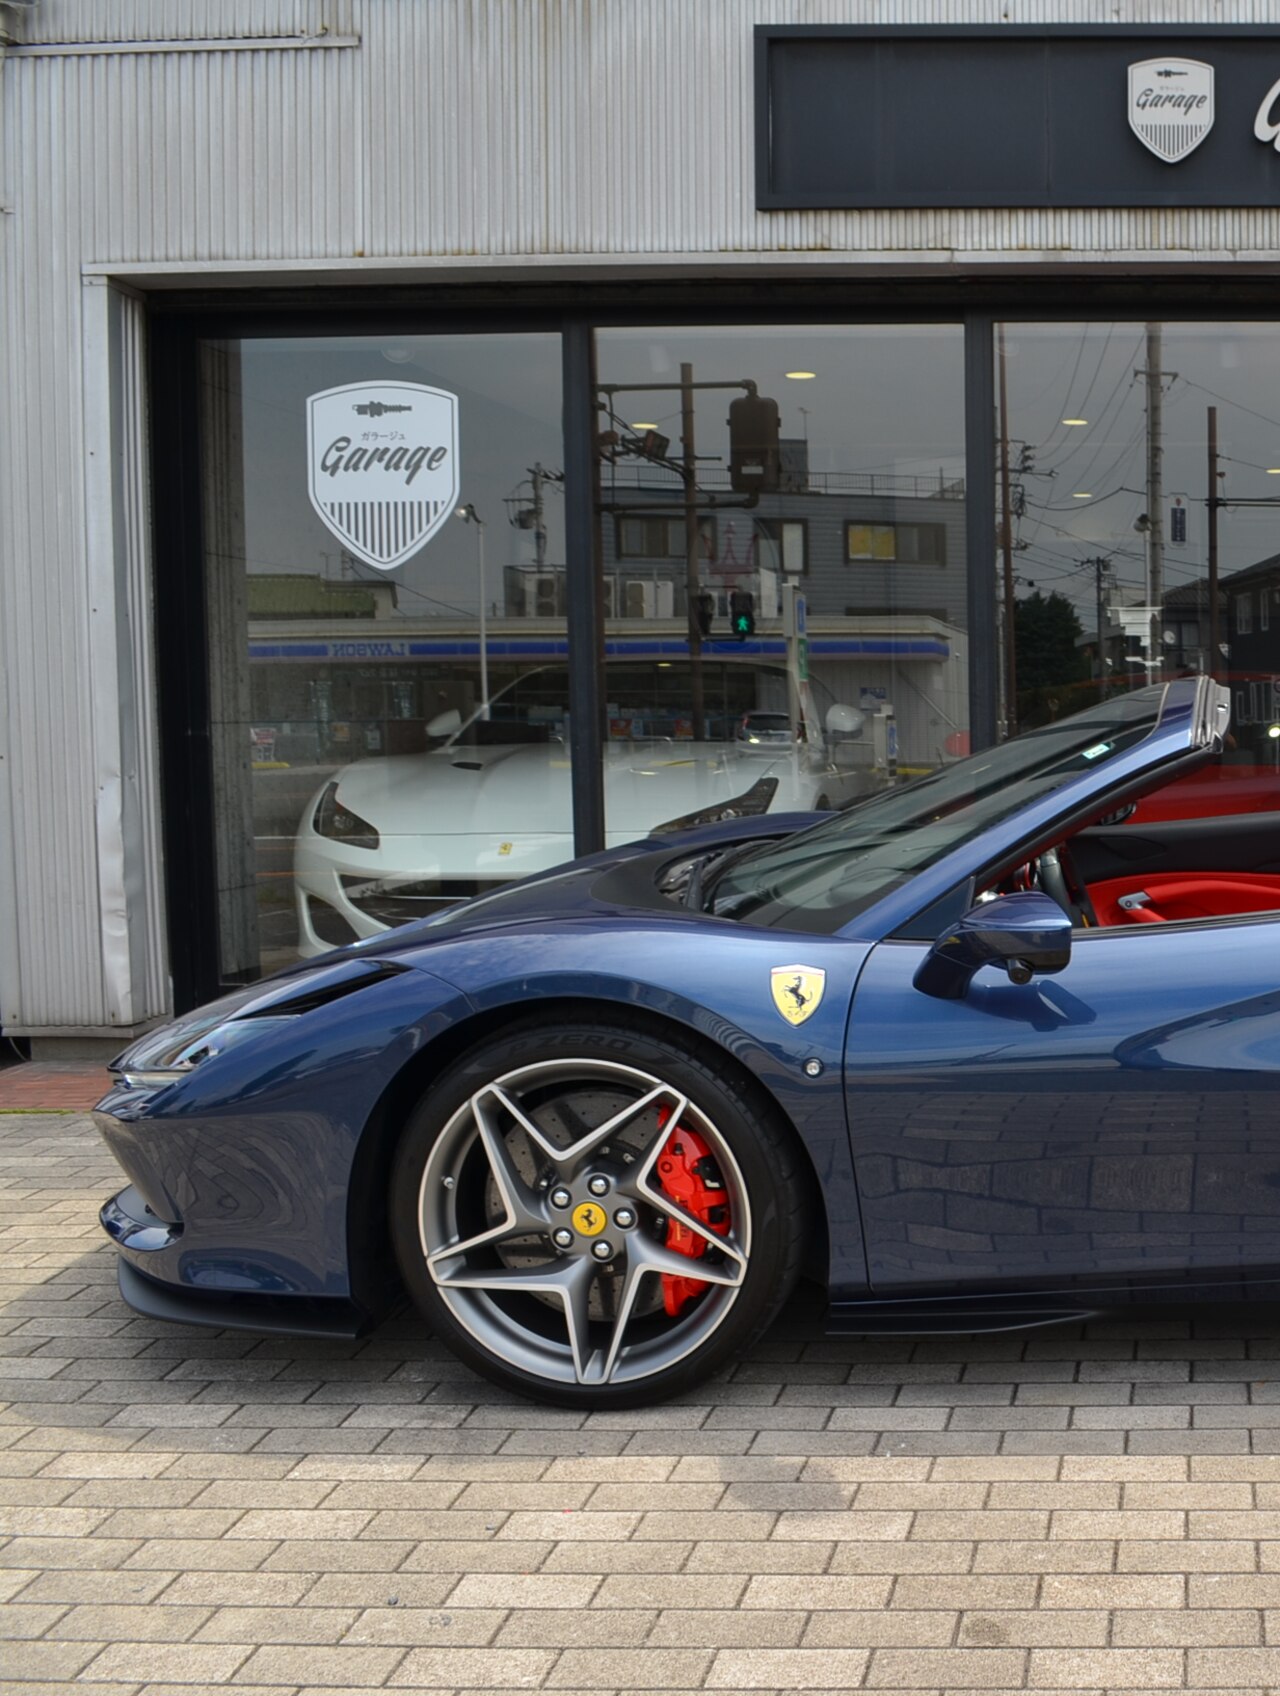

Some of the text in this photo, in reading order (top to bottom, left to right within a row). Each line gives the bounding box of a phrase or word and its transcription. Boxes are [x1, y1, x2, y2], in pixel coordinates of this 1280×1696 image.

[1136, 88, 1208, 116] Garage
[361, 430, 406, 441] ガラージュ
[321, 436, 448, 486] Garage
[508, 1033, 633, 1057] P ZERO
